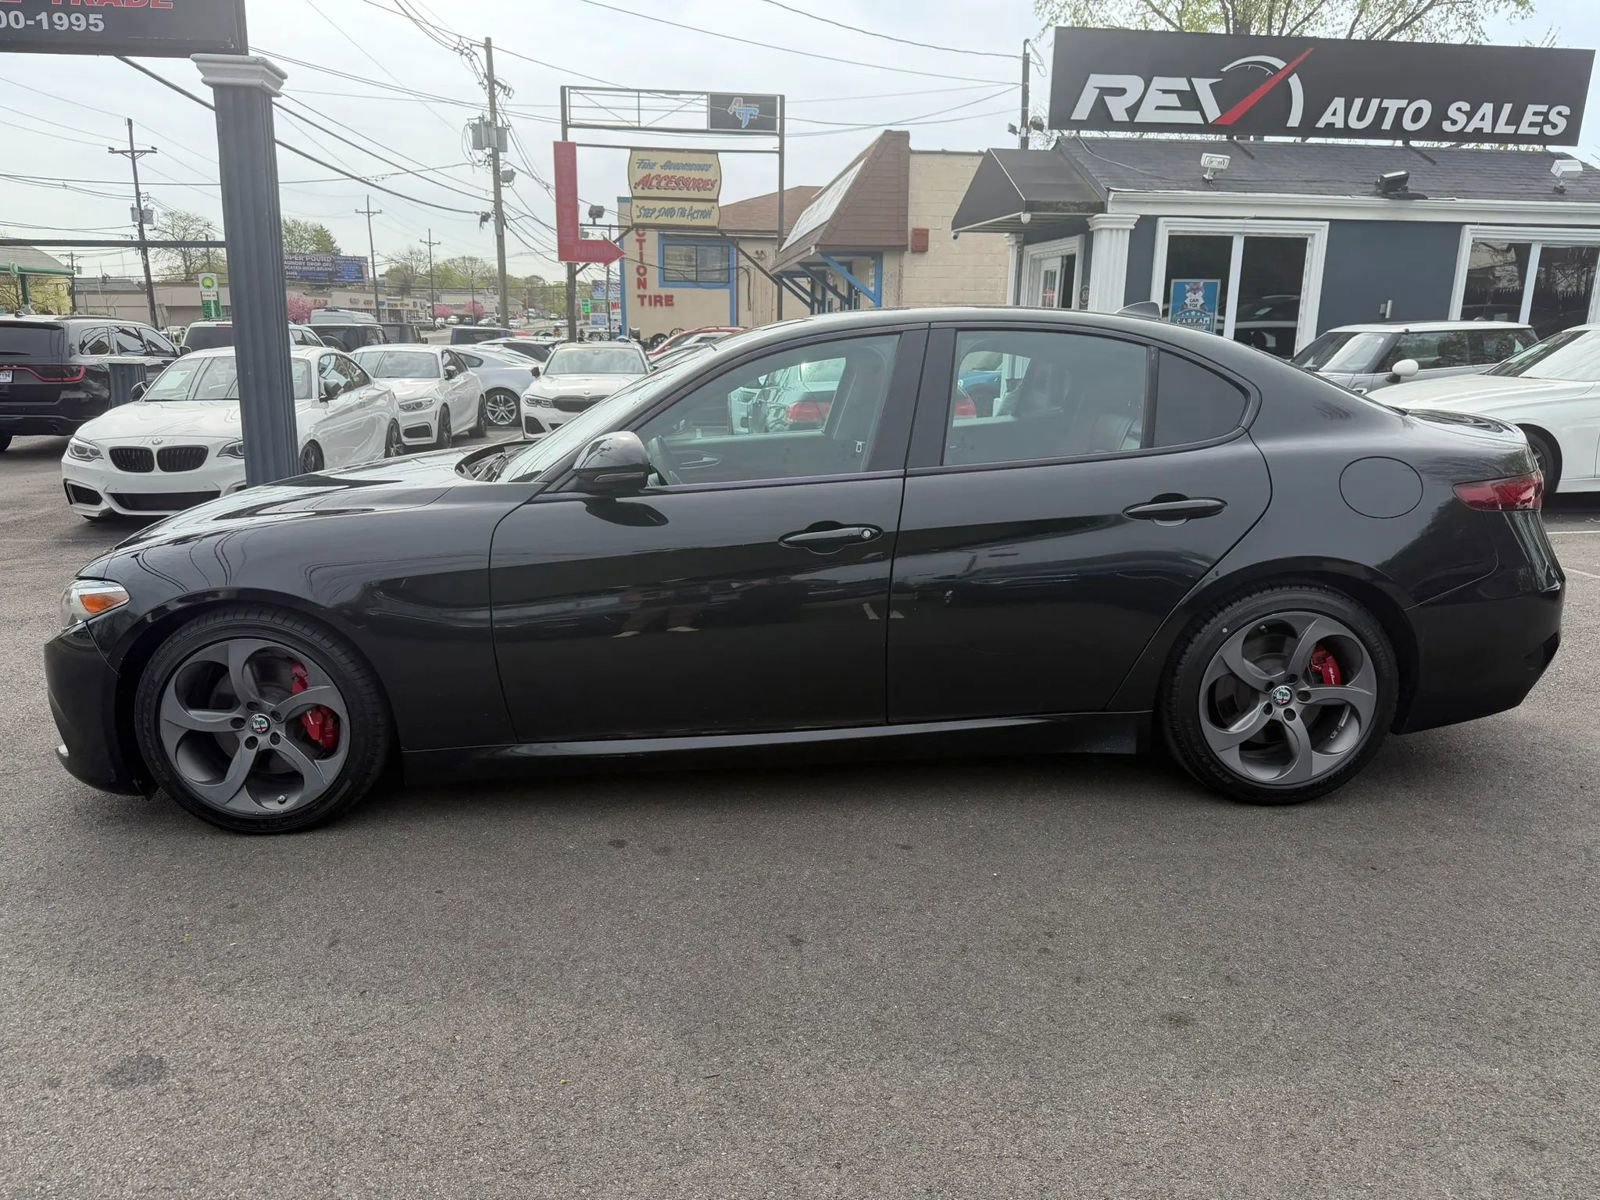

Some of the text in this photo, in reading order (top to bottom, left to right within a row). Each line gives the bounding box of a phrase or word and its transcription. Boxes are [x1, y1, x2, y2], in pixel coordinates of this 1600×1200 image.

[1315, 97, 1432, 132] AUTO
[1441, 101, 1571, 137] SALES
[633, 172, 718, 192] ACCESSORIES
[637, 294, 675, 307] TIRE
